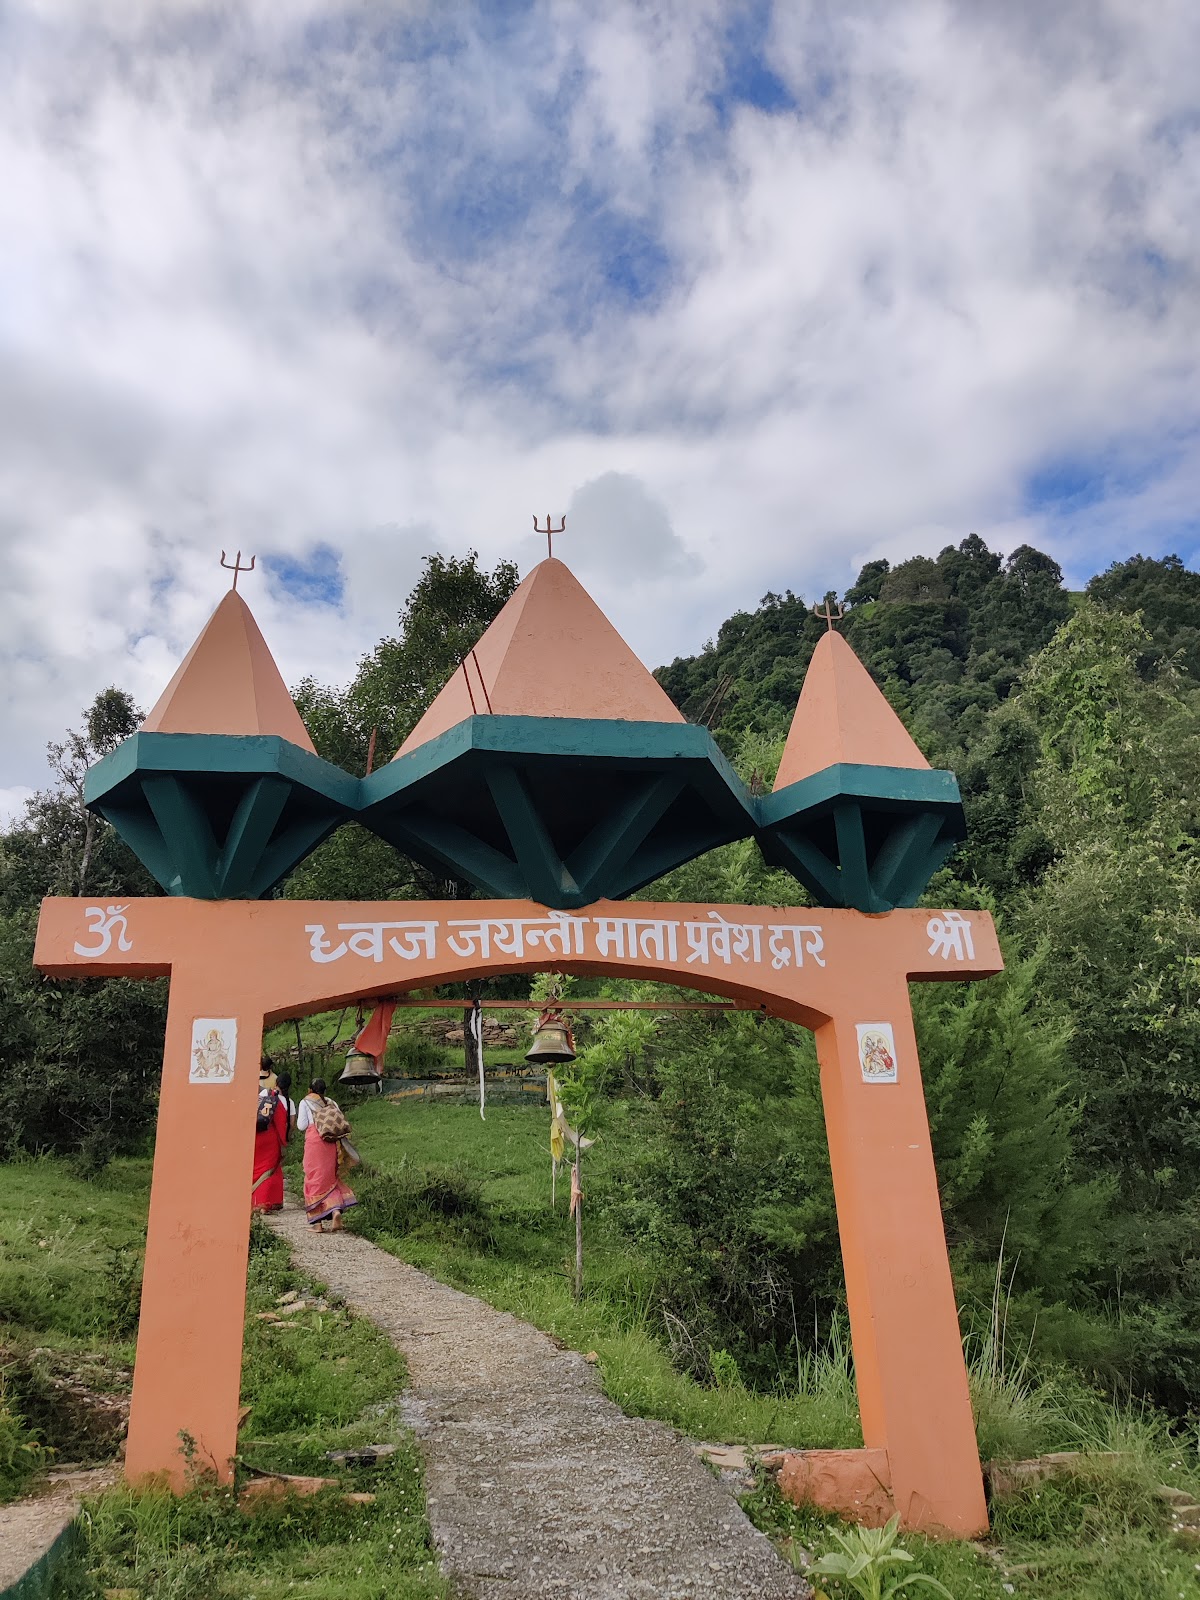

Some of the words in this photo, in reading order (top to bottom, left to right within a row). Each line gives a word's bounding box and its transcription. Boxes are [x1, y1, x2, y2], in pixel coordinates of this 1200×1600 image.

[74, 904, 132, 958] ॐ
[304, 920, 440, 963] ध्वज
[446, 910, 590, 959] जयन्ती
[593, 917, 680, 962] माता
[683, 910, 764, 965] प्रवेश
[767, 924, 827, 971] द्वार
[926, 911, 976, 961] श्री
